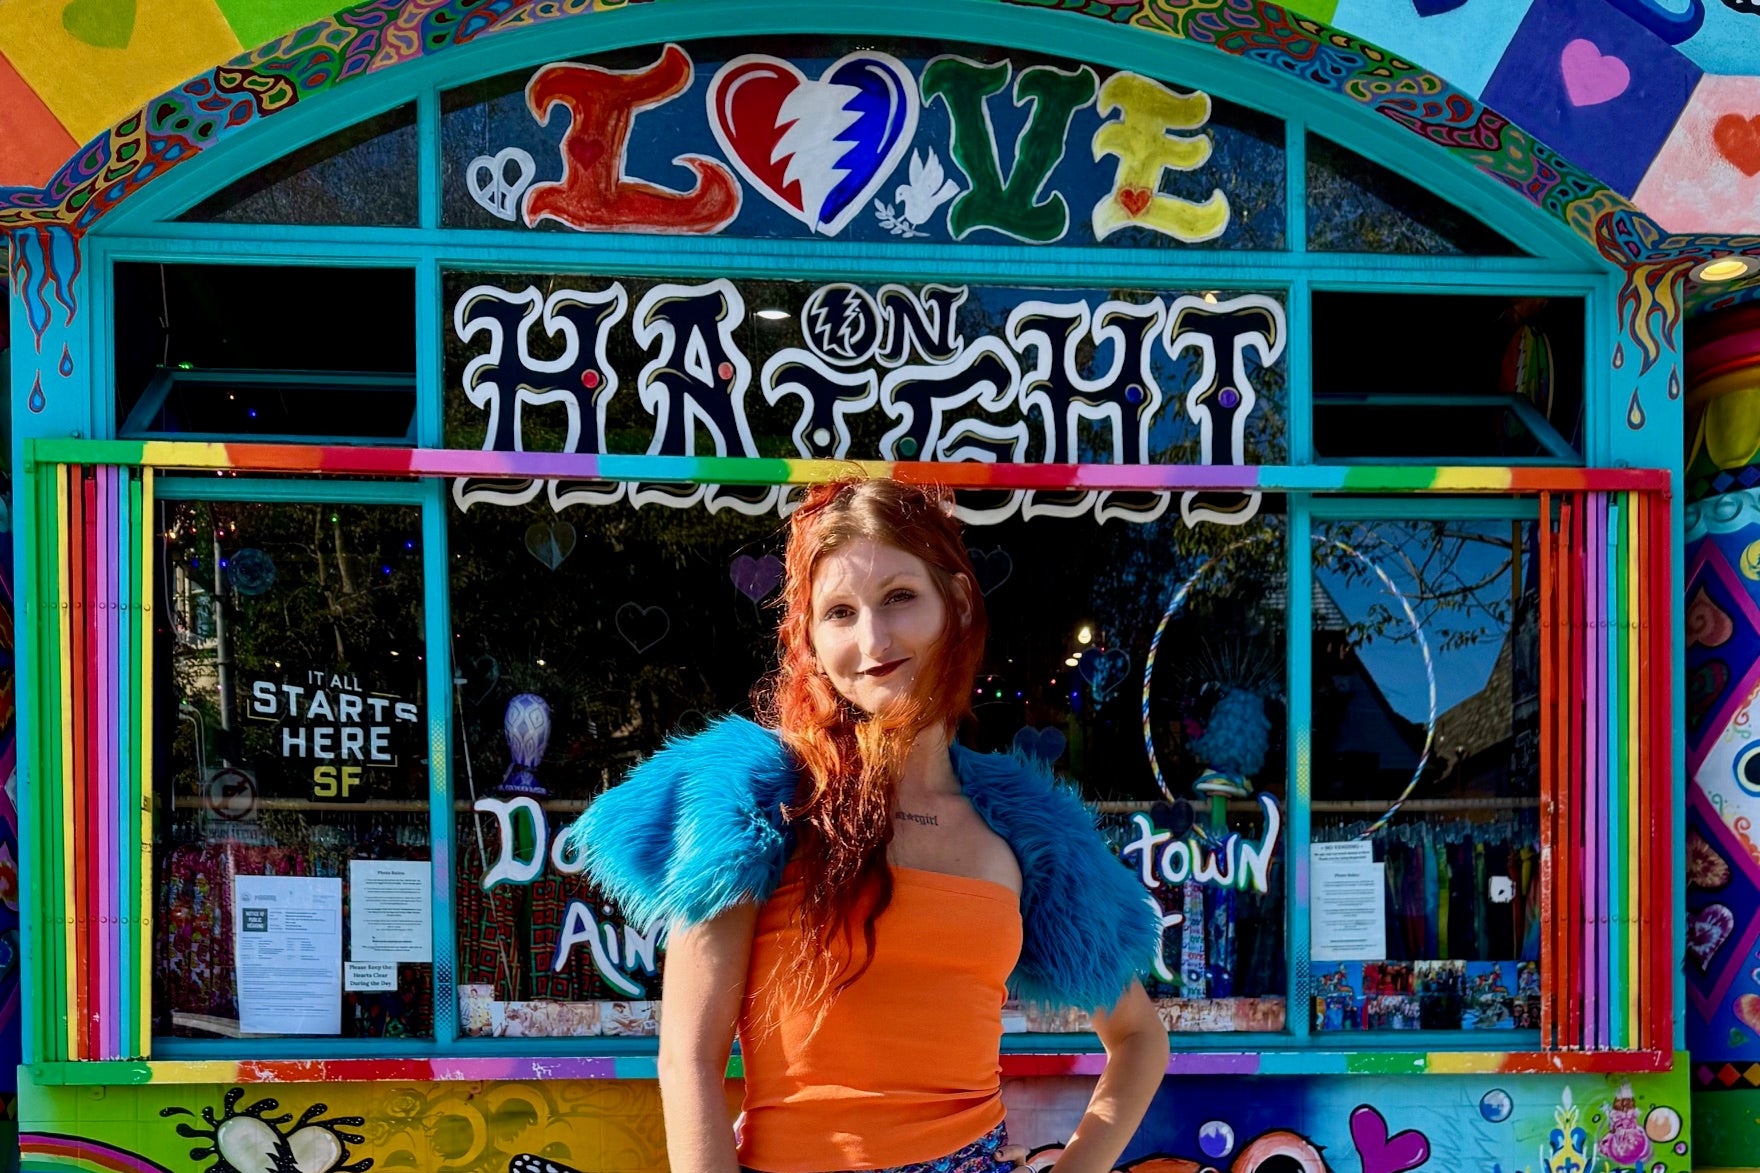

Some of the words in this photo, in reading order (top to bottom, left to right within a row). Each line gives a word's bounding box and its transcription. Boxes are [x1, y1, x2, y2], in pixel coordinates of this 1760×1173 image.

[522, 43, 1230, 244] LOVE
[801, 283, 968, 368] ON
[308, 670, 324, 686] IT
[330, 674, 362, 692] ALL
[253, 680, 418, 723] STARTS
[282, 726, 391, 761] HERE
[313, 765, 362, 797] SF
